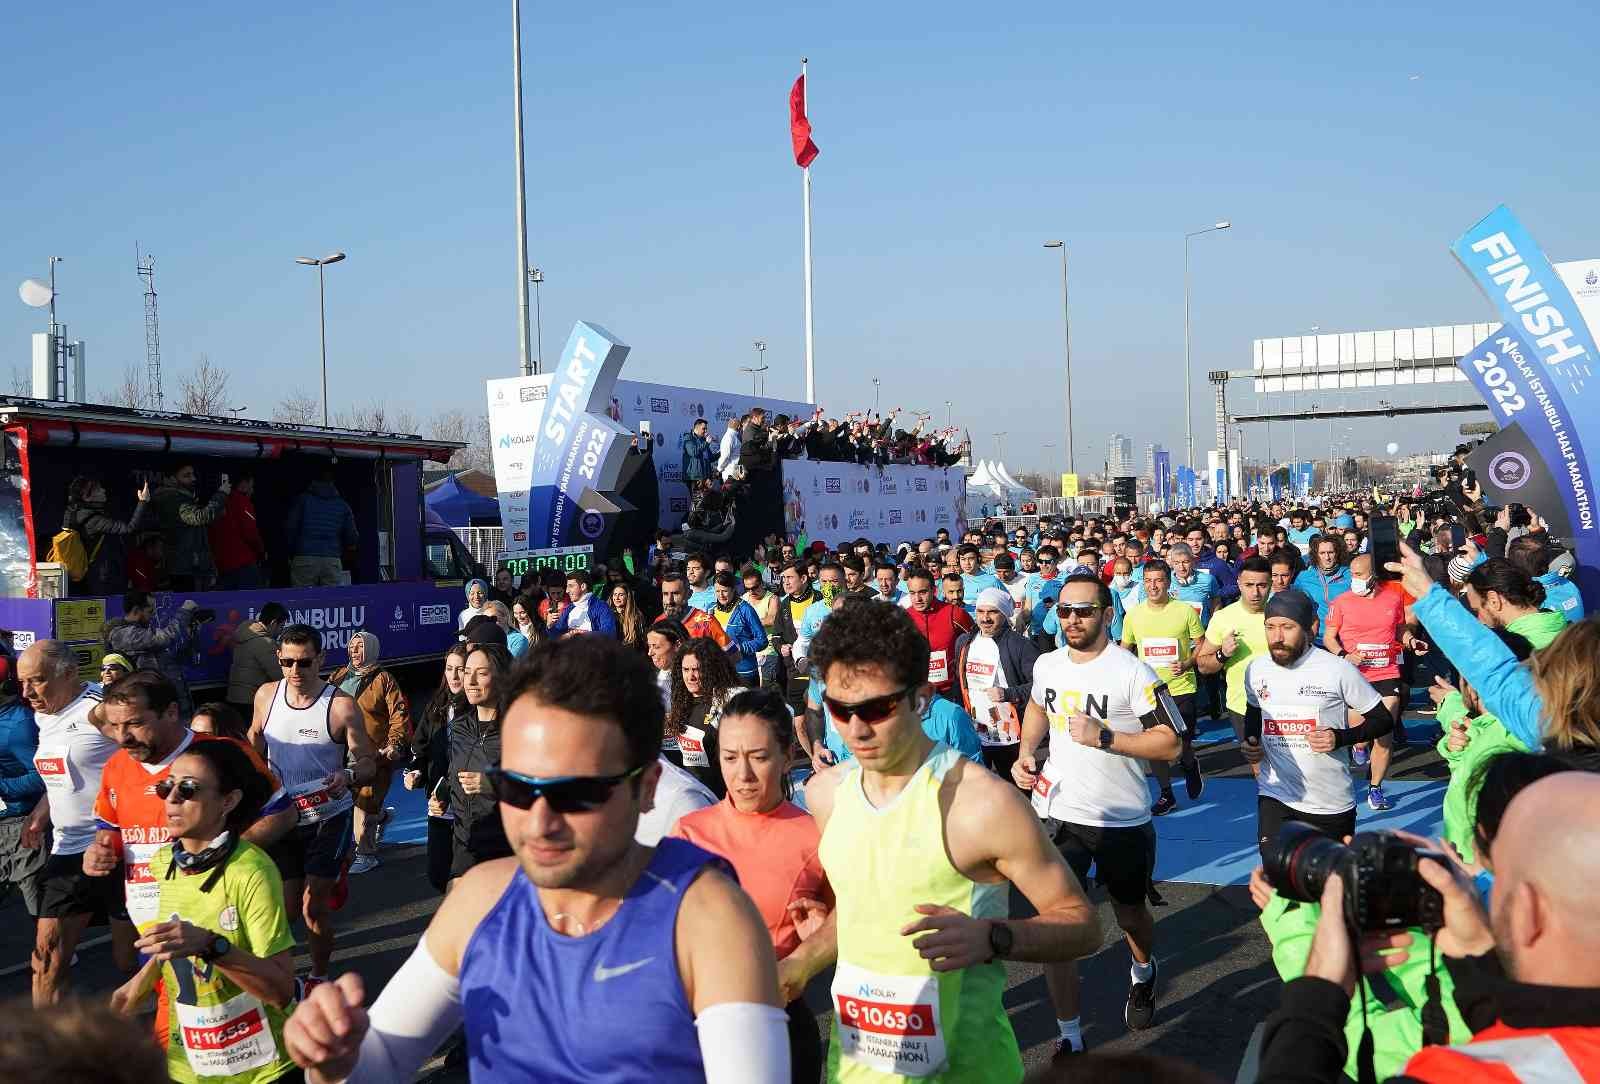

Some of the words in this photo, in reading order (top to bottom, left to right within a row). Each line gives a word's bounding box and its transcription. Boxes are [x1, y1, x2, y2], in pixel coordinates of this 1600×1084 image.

[1471, 231, 1586, 366] FINISH
[545, 336, 597, 447] START
[1473, 352, 1527, 418] 2022
[579, 428, 607, 480] 2022
[1555, 431, 1575, 464] HALF
[1567, 460, 1593, 530] MARATHON
[14, 632, 33, 642] POR
[421, 607, 448, 616] SPOR
[867, 1046, 924, 1063] MARATHON
[900, 1041, 921, 1051] HALF
